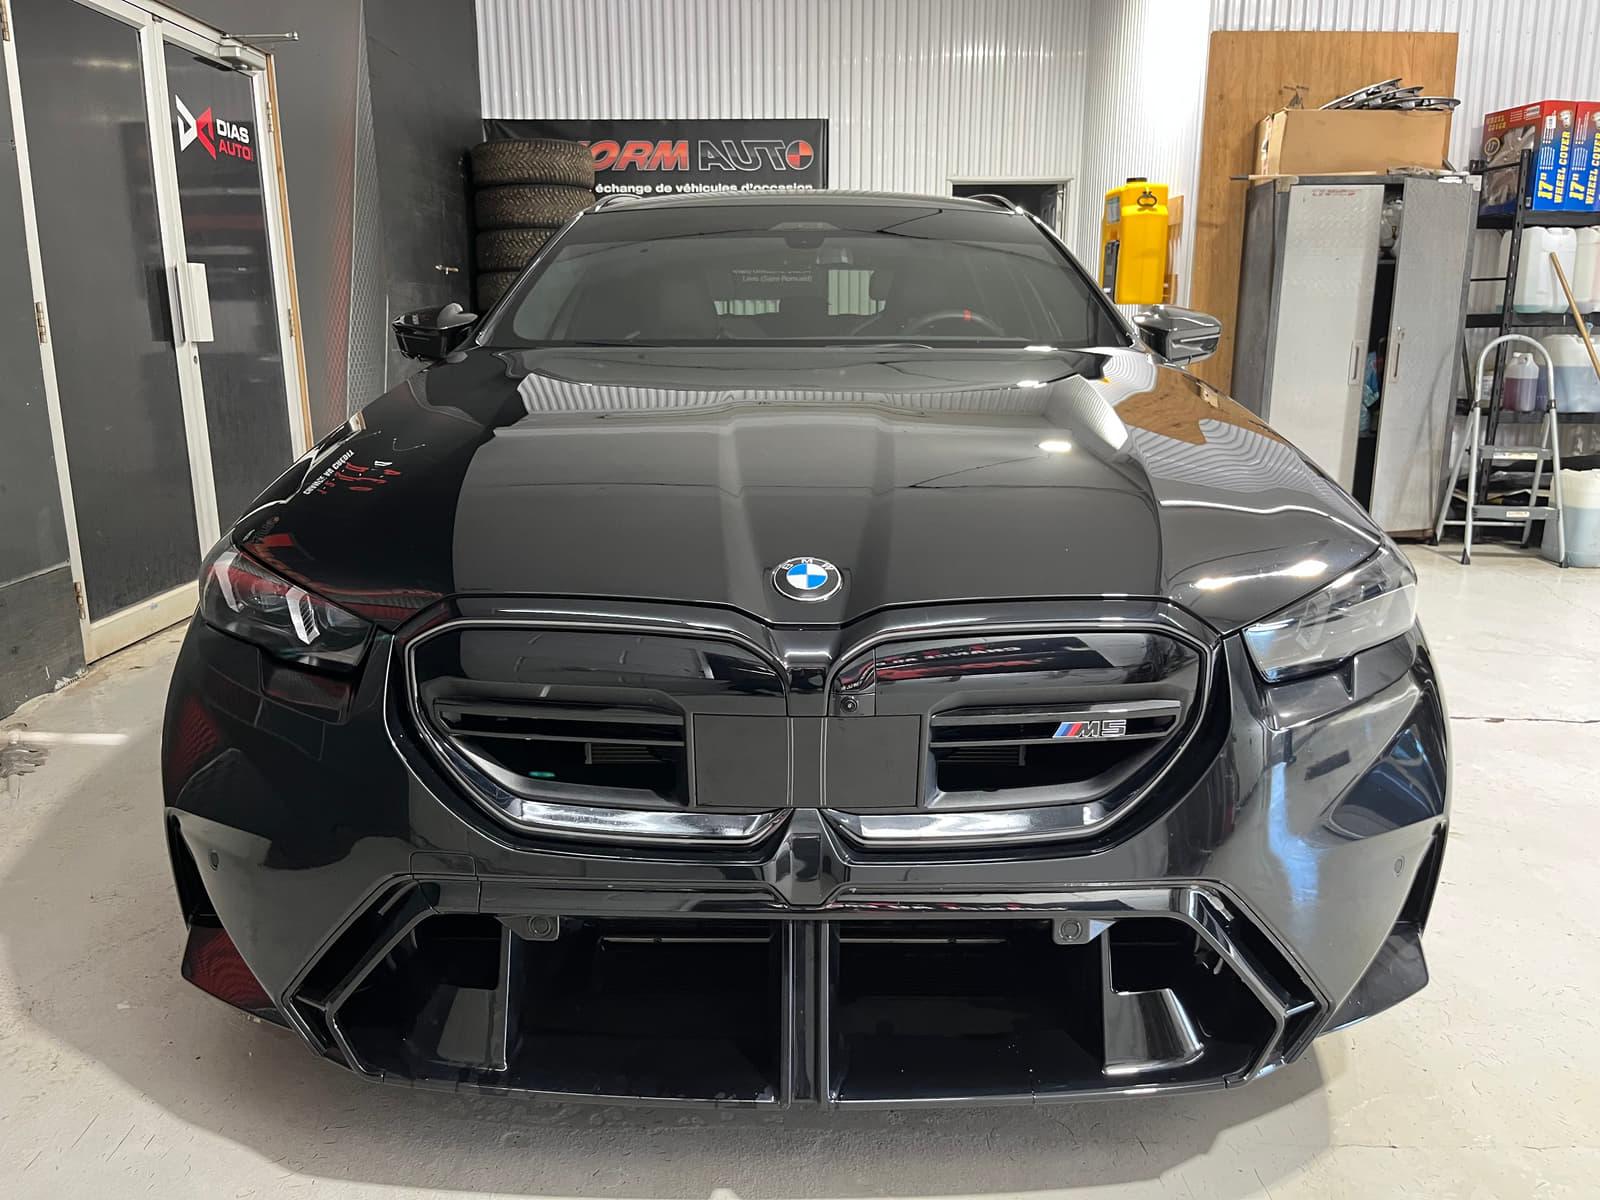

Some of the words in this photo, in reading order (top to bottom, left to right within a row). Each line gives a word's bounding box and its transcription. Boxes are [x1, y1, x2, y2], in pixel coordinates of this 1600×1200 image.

[216, 118, 249, 144] DIAS
[219, 140, 252, 160] AUTO
[577, 140, 689, 171] ORM
[1559, 131, 1570, 165] COVER
[595, 183, 652, 193] échange
[655, 183, 673, 193] de
[676, 183, 737, 193] véhicules
[1554, 167, 1566, 203] WHEEL
[1585, 168, 1598, 204] WHEEL
[1072, 719, 1127, 738] M5
